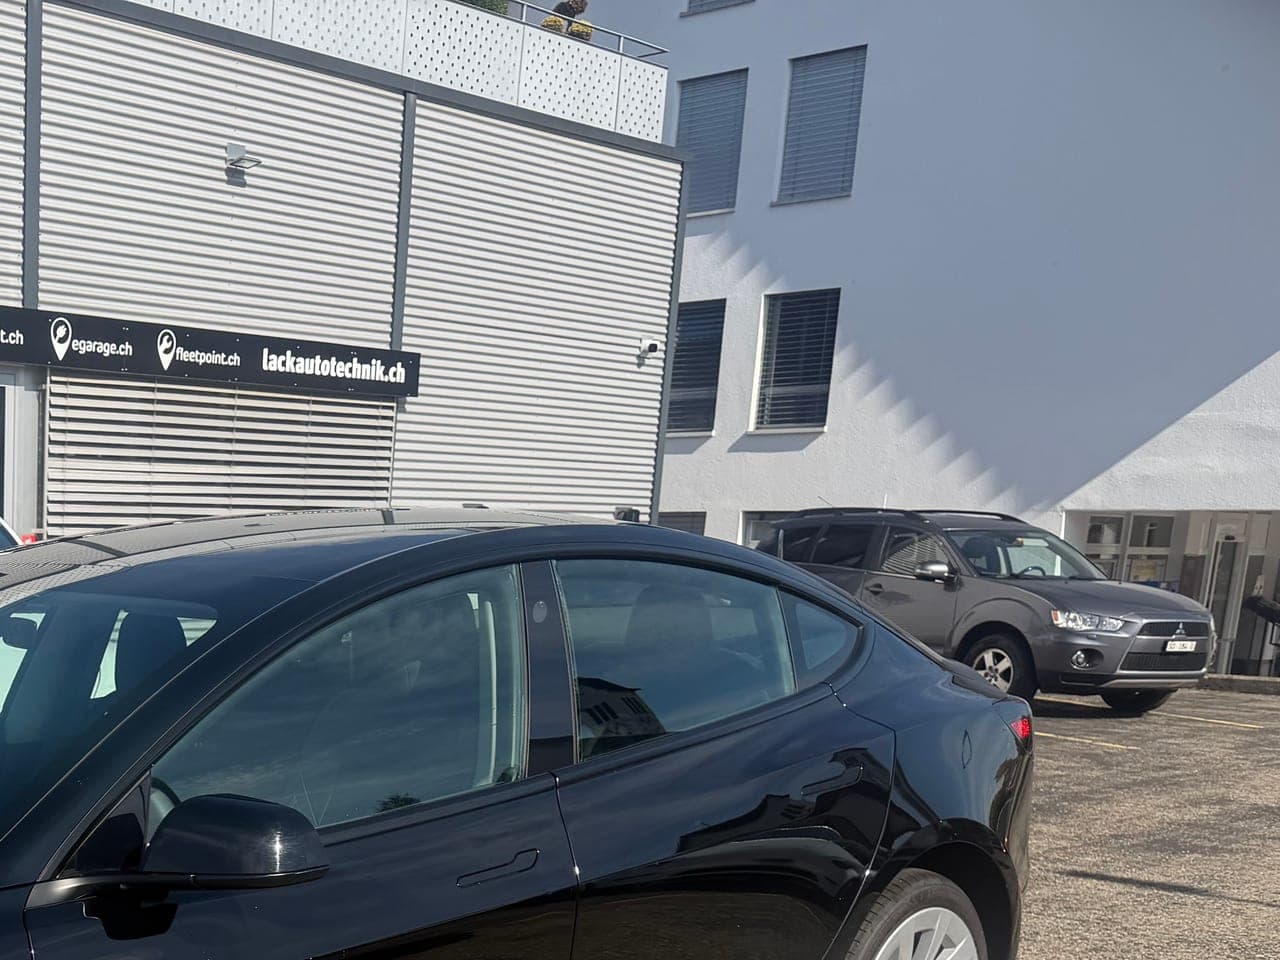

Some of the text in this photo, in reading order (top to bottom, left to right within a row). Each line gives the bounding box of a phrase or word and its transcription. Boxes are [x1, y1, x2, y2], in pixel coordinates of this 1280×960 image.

[71, 338, 133, 357] egarage.ch
[176, 346, 241, 367] fleetpoint.ch
[262, 348, 406, 383] lackautotechnik.ch
